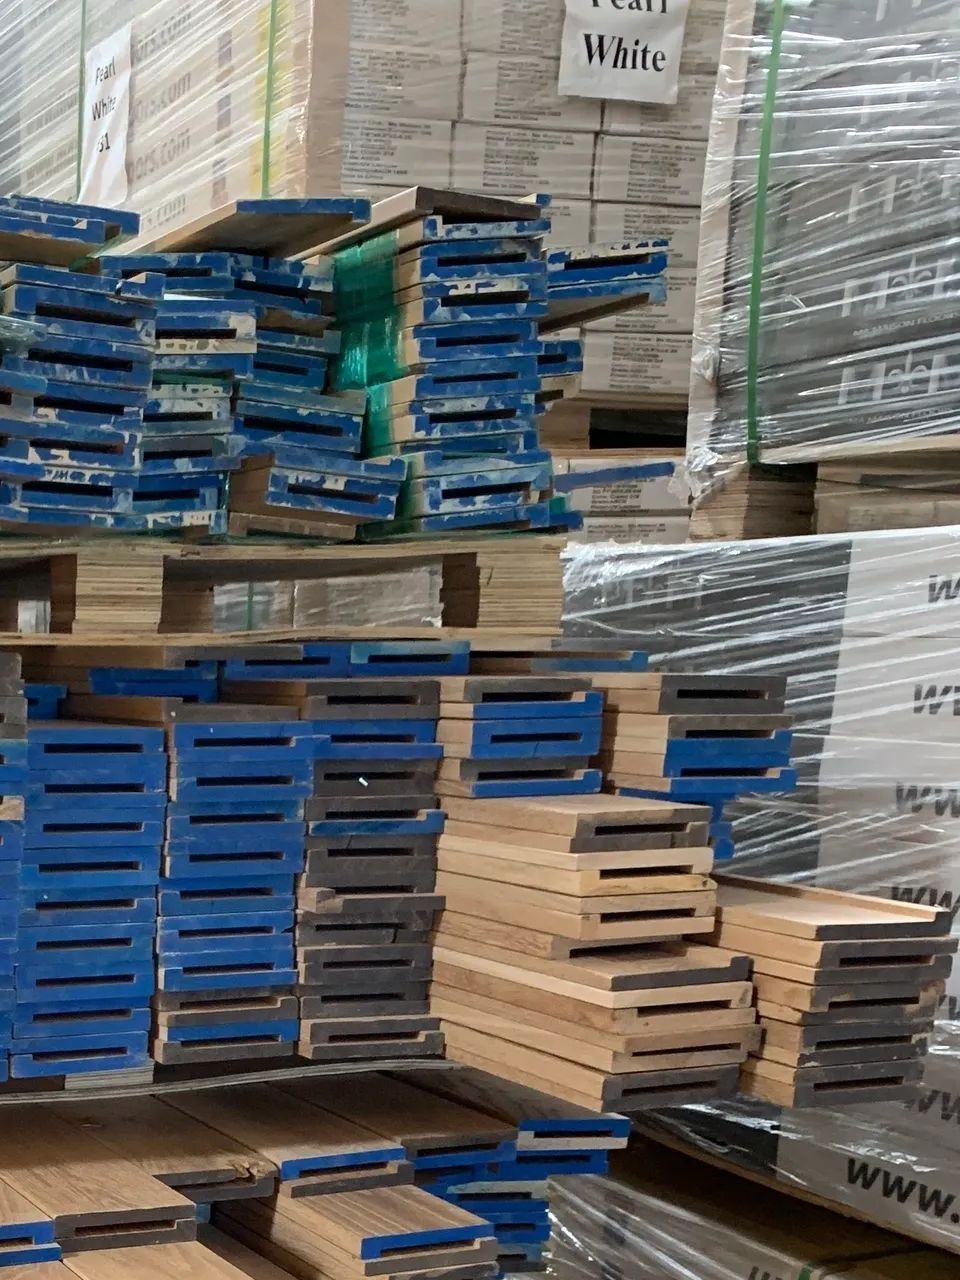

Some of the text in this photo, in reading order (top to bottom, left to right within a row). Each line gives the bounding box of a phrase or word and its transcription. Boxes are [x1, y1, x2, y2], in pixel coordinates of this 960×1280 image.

[583, 33, 667, 73] White
[95, 56, 116, 86] Pearl
[91, 95, 116, 121] White
